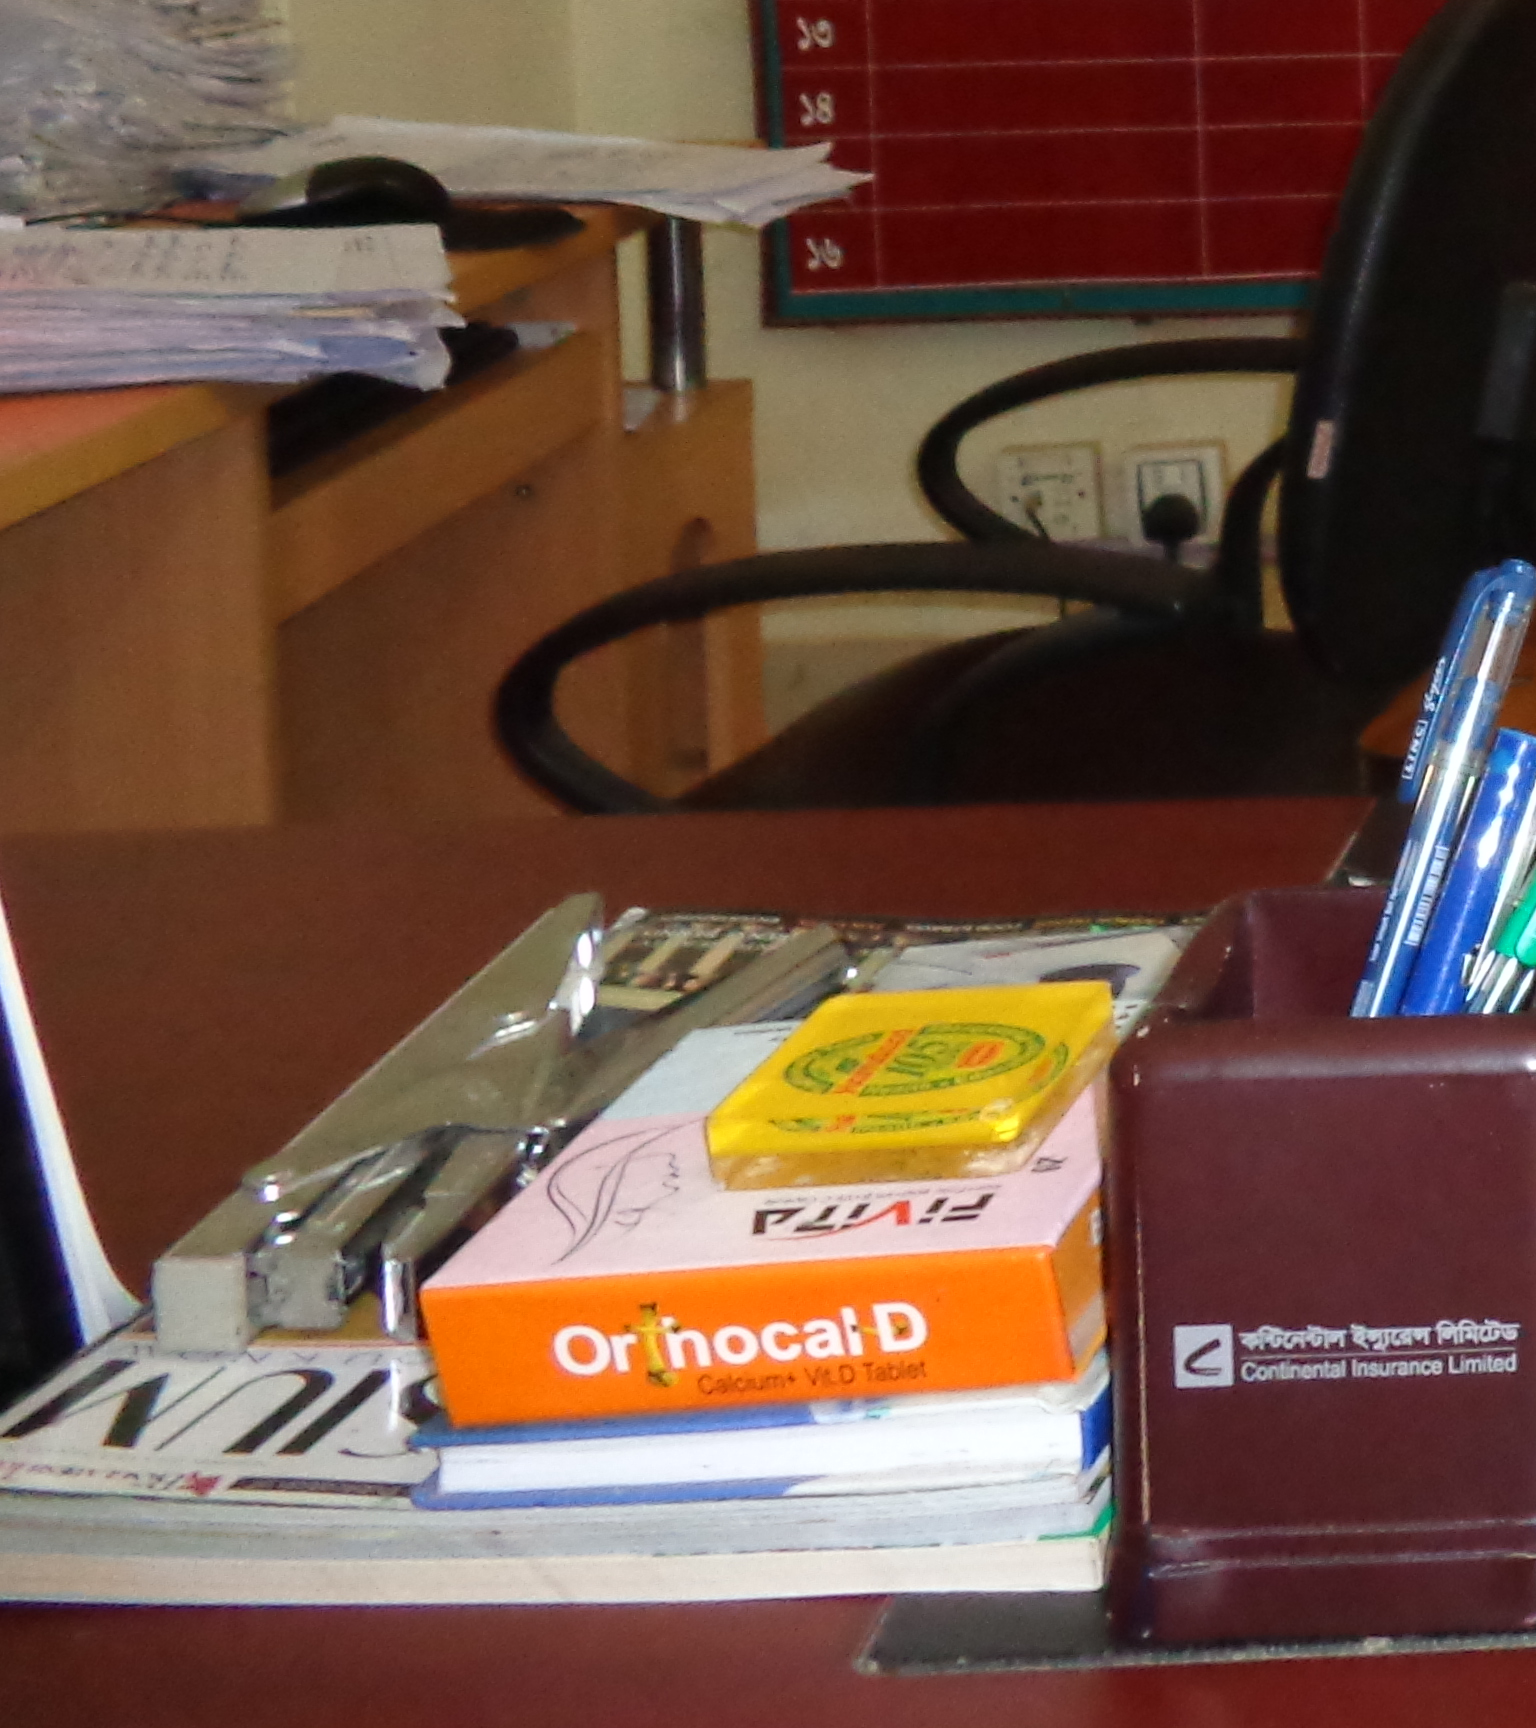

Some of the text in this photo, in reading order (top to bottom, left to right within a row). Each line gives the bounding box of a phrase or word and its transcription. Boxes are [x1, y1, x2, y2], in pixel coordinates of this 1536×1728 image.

[796, 17, 836, 51] ১৩
[799, 92, 836, 126] ১৪
[861, 1360, 928, 1384] Tablet
[1240, 1353, 1517, 1382] Continental Insurance Limited
